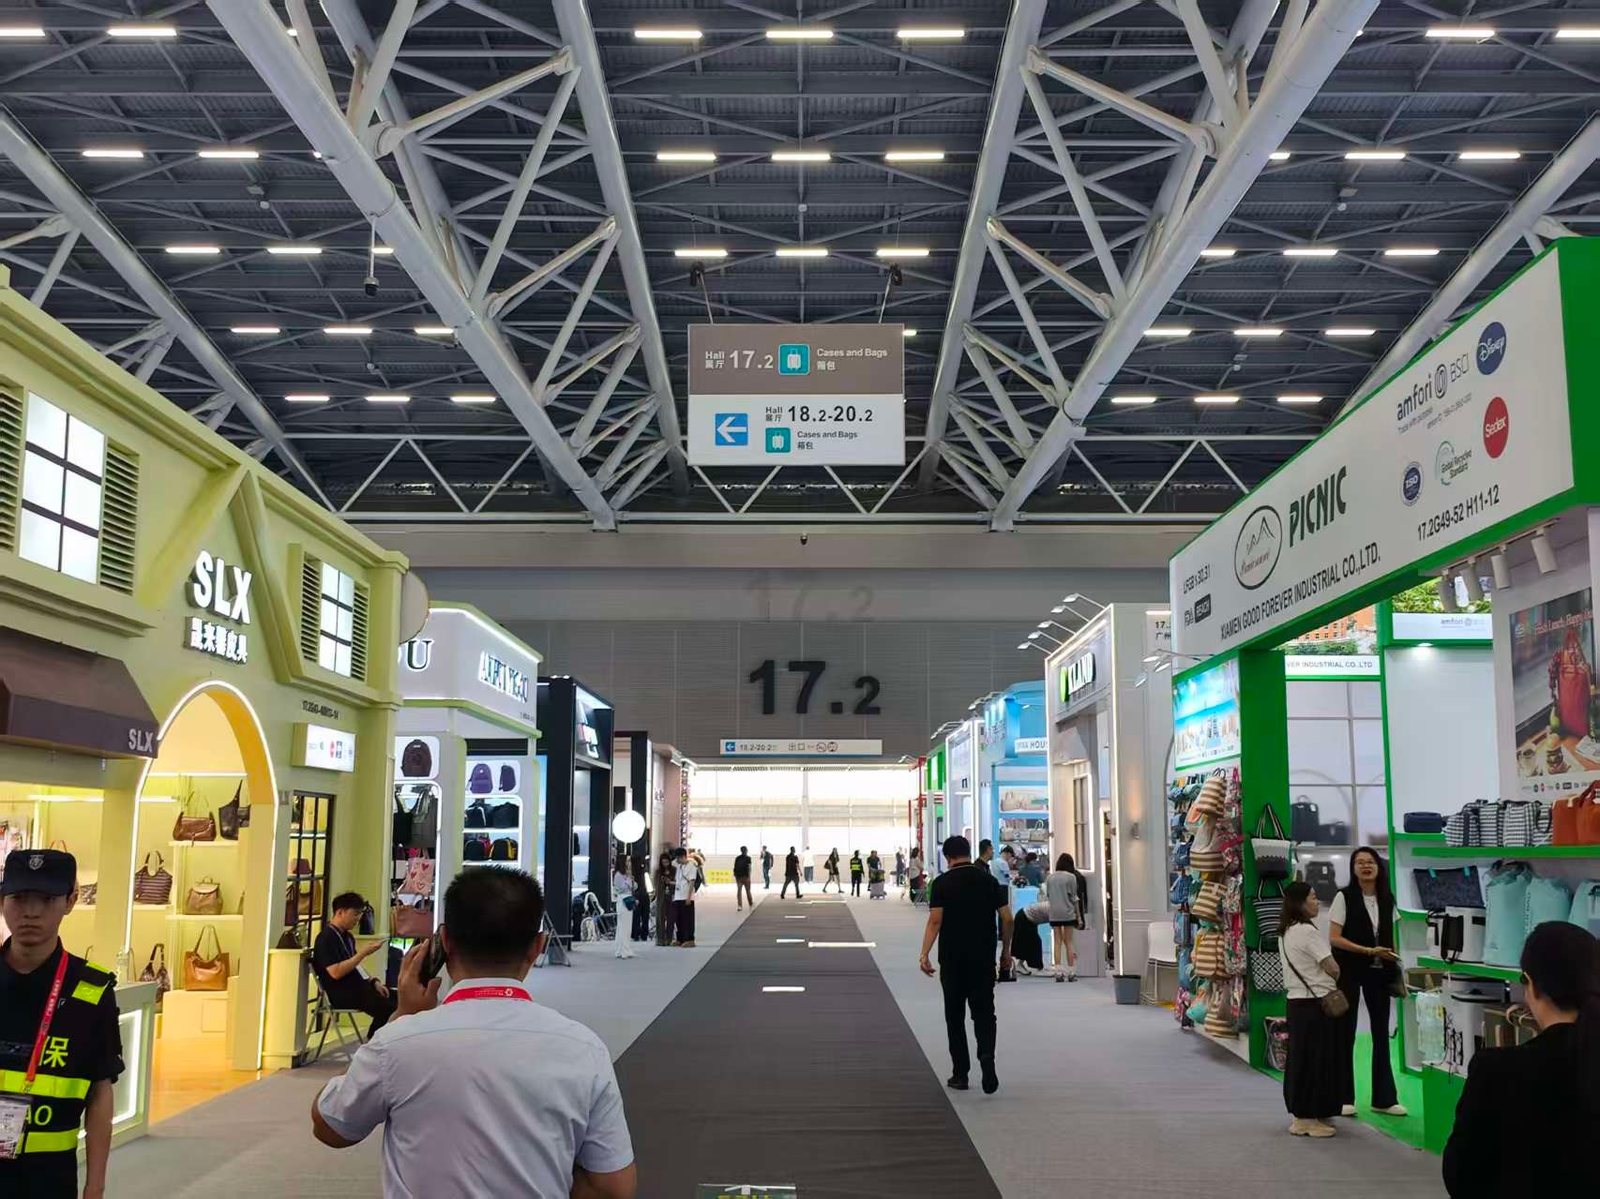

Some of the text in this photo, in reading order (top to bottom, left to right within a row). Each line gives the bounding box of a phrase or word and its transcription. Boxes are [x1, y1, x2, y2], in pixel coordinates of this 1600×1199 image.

[705, 351, 725, 359] Hall
[729, 350, 774, 369] 17.2
[817, 348, 888, 358] Cases and Bags
[705, 359, 725, 369] 展厅
[816, 361, 837, 371] 箱包
[1397, 373, 1433, 421] amfori
[1450, 352, 1469, 382] BSCI
[765, 406, 783, 414] Hall
[788, 405, 873, 423] 18.2-20.2
[765, 414, 783, 422] 展厅
[797, 430, 858, 440] Cases and Bags
[797, 441, 814, 450] 箱包
[1289, 465, 1347, 548] PICNIC
[1417, 484, 1500, 542] 17.2G49-52 H11-12
[193, 550, 252, 624] SLX
[1220, 620, 1243, 641] XIAMEN
[1242, 606, 1261, 629] GOOD
[1261, 590, 1294, 618] FOREVER
[1293, 564, 1341, 600] INDUSTRIAL
[1302, 661, 1344, 669] INDUSTRIAL
[749, 659, 882, 716] 17.2
[129, 728, 153, 753] SLX
